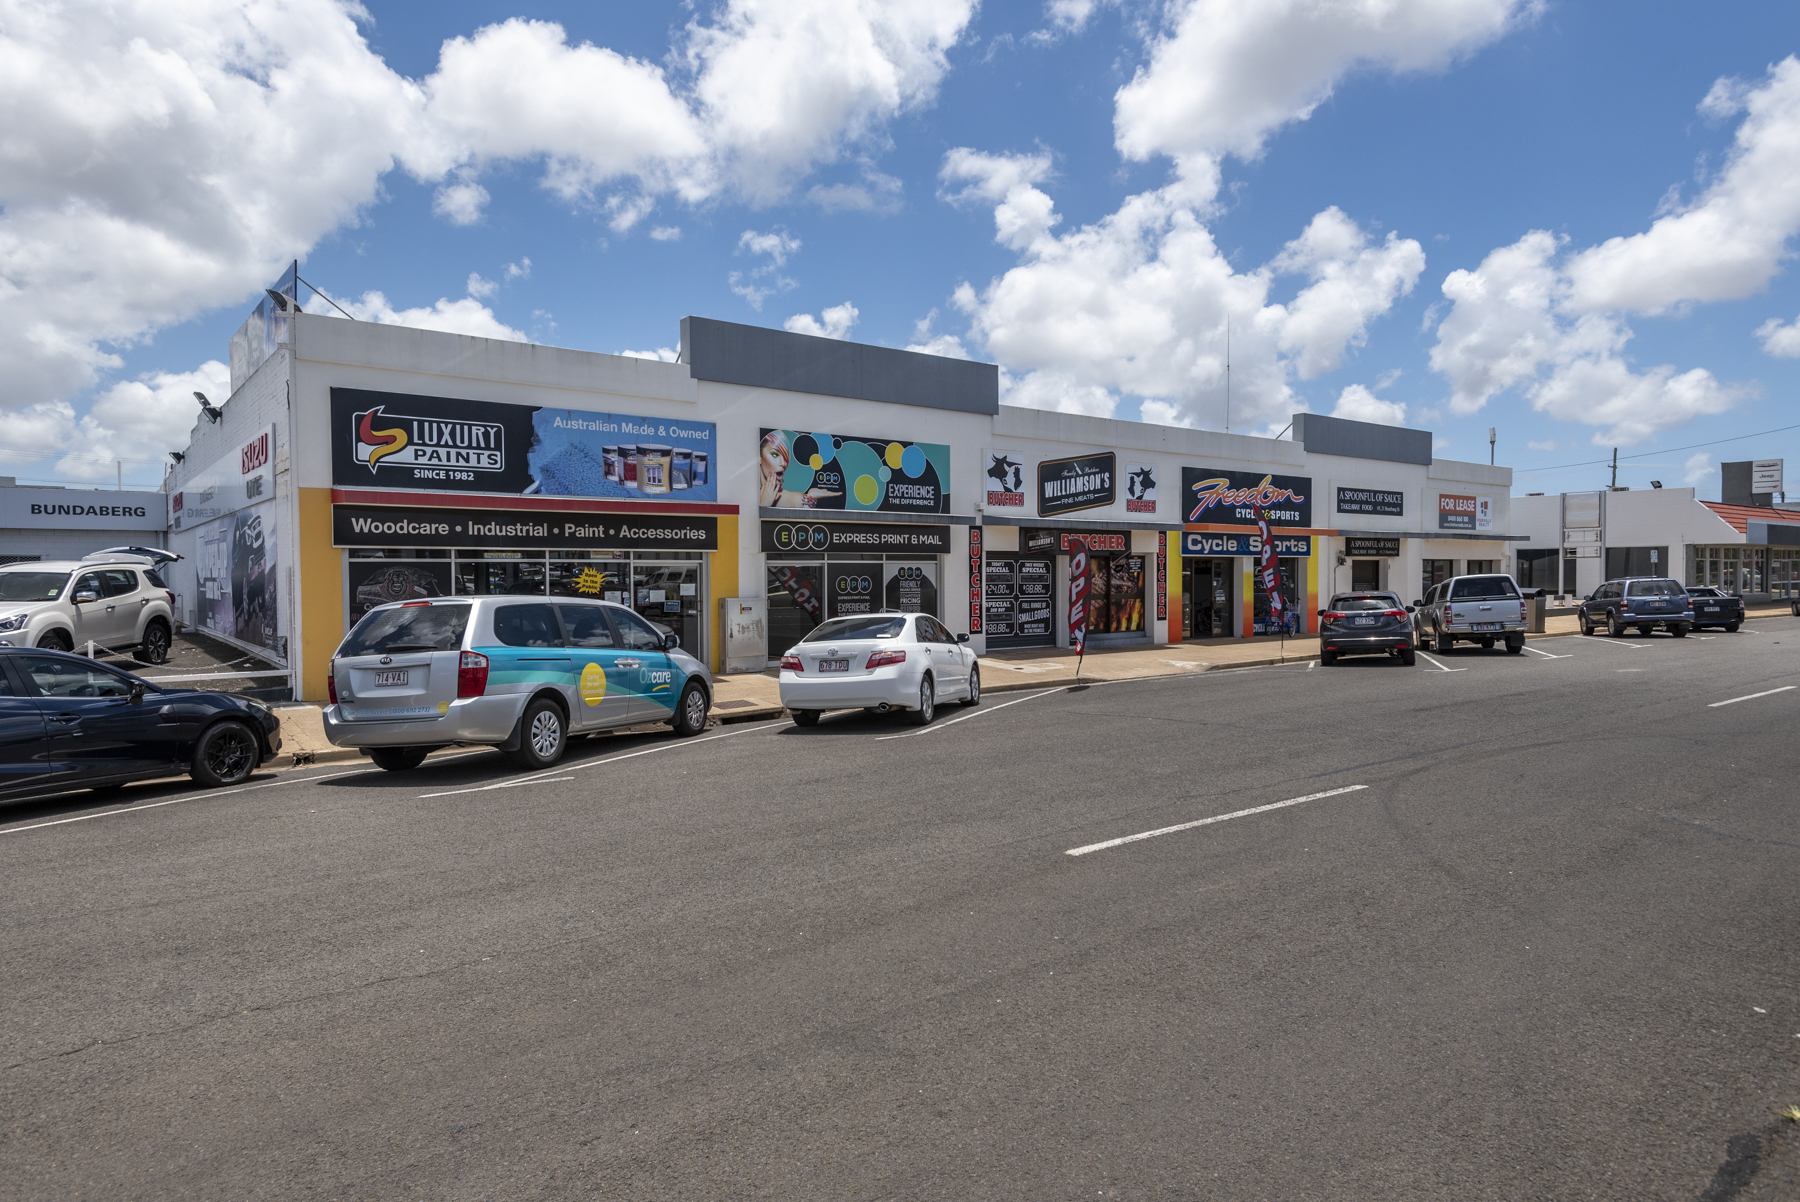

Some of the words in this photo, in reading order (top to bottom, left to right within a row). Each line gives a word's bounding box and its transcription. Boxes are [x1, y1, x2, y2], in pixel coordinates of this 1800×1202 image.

[413, 421, 498, 448] LUXURY
[553, 416, 618, 433] Australian
[621, 422, 655, 435] Made
[658, 425, 667, 437] &
[669, 426, 709, 440] Owned
[241, 433, 268, 475] ISUZU
[414, 448, 499, 466] PAINTS
[414, 469, 446, 479] SINCE
[449, 471, 475, 481] 1982
[246, 475, 263, 499] UTE
[888, 484, 935, 498] EXPERIENCE
[1044, 472, 1110, 498] WILLIAMSON'S
[901, 498, 935, 506] DIFFERENCE
[988, 492, 1024, 506] BUTCHER
[1075, 493, 1095, 502] MEATS
[1190, 474, 1304, 521] Freedom
[1339, 491, 1344, 499] A
[1345, 491, 1375, 502] SPOONFUL
[1376, 493, 1384, 502] OF
[1384, 494, 1402, 504] SAUCE
[1441, 498, 1455, 510] FOR
[1456, 499, 1475, 511] LEASE
[31, 504, 146, 517] BUNDABERG
[1128, 500, 1156, 512] BUTCHER
[1236, 508, 1264, 519] CYCL
[1271, 510, 1300, 520] SPORTS
[351, 517, 449, 534] Woodcare
[468, 520, 548, 537] Industrial
[564, 523, 605, 538] Paint
[619, 525, 706, 539] Accessories
[781, 532, 824, 543] EPM
[833, 533, 880, 543] EXPRESS
[881, 533, 909, 544] PRINT
[911, 534, 918, 544] &
[919, 534, 942, 545] MAIL
[1061, 534, 1126, 550] BTCHER
[1187, 534, 1238, 554] Cycle
[1249, 536, 1308, 552] Sorts
[970, 530, 981, 631] BUTCHER
[1158, 534, 1166, 617] BUTCHER
[841, 581, 869, 589] EPM
[838, 603, 871, 612] EXPERIENCE
[1018, 608, 1050, 623] SMALLGOODS
[640, 667, 671, 684] Ozcare
[583, 687, 604, 695] Community
